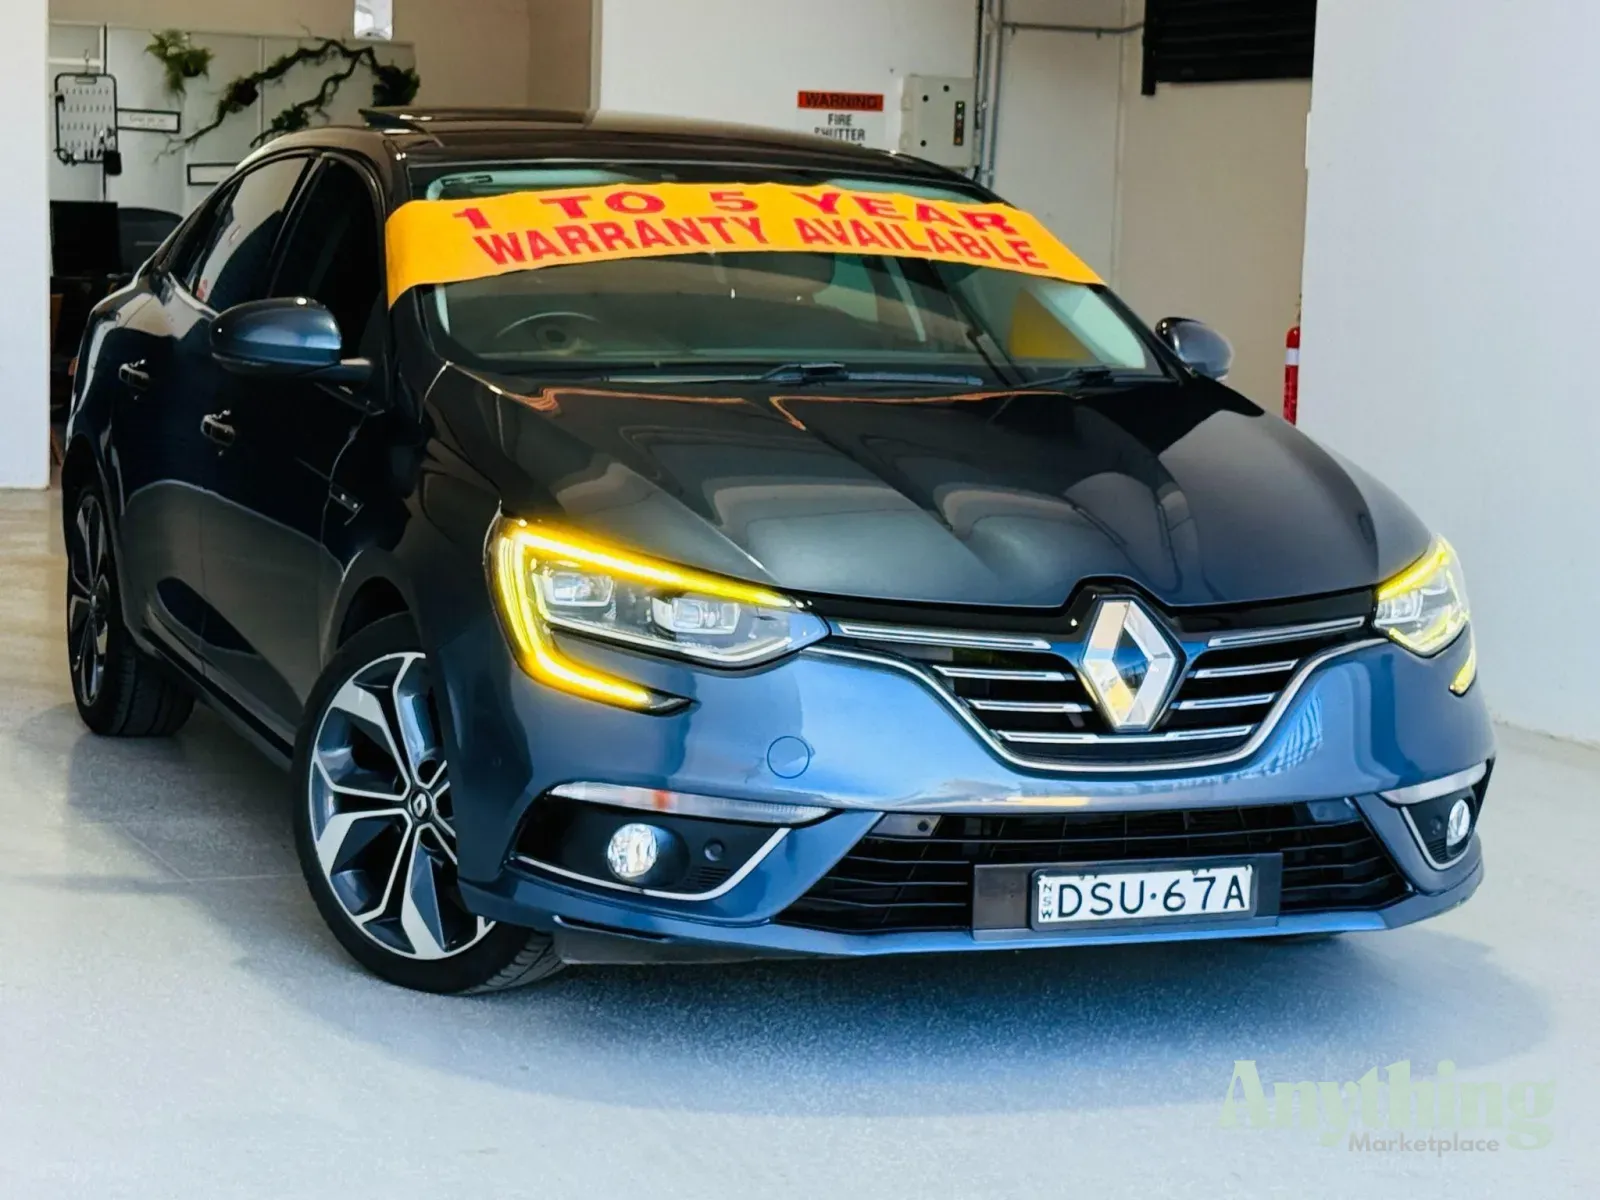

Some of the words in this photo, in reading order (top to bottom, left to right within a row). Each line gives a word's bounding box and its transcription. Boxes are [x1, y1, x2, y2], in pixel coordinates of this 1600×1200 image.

[805, 92, 879, 110] WARNING
[827, 113, 853, 126] FIRE
[452, 207, 492, 230] 1
[539, 190, 666, 219] TO
[710, 190, 759, 212] 5
[791, 191, 1019, 236] YEAR
[472, 215, 769, 266] WARRANTY
[793, 217, 1049, 269] AVAILABLE
